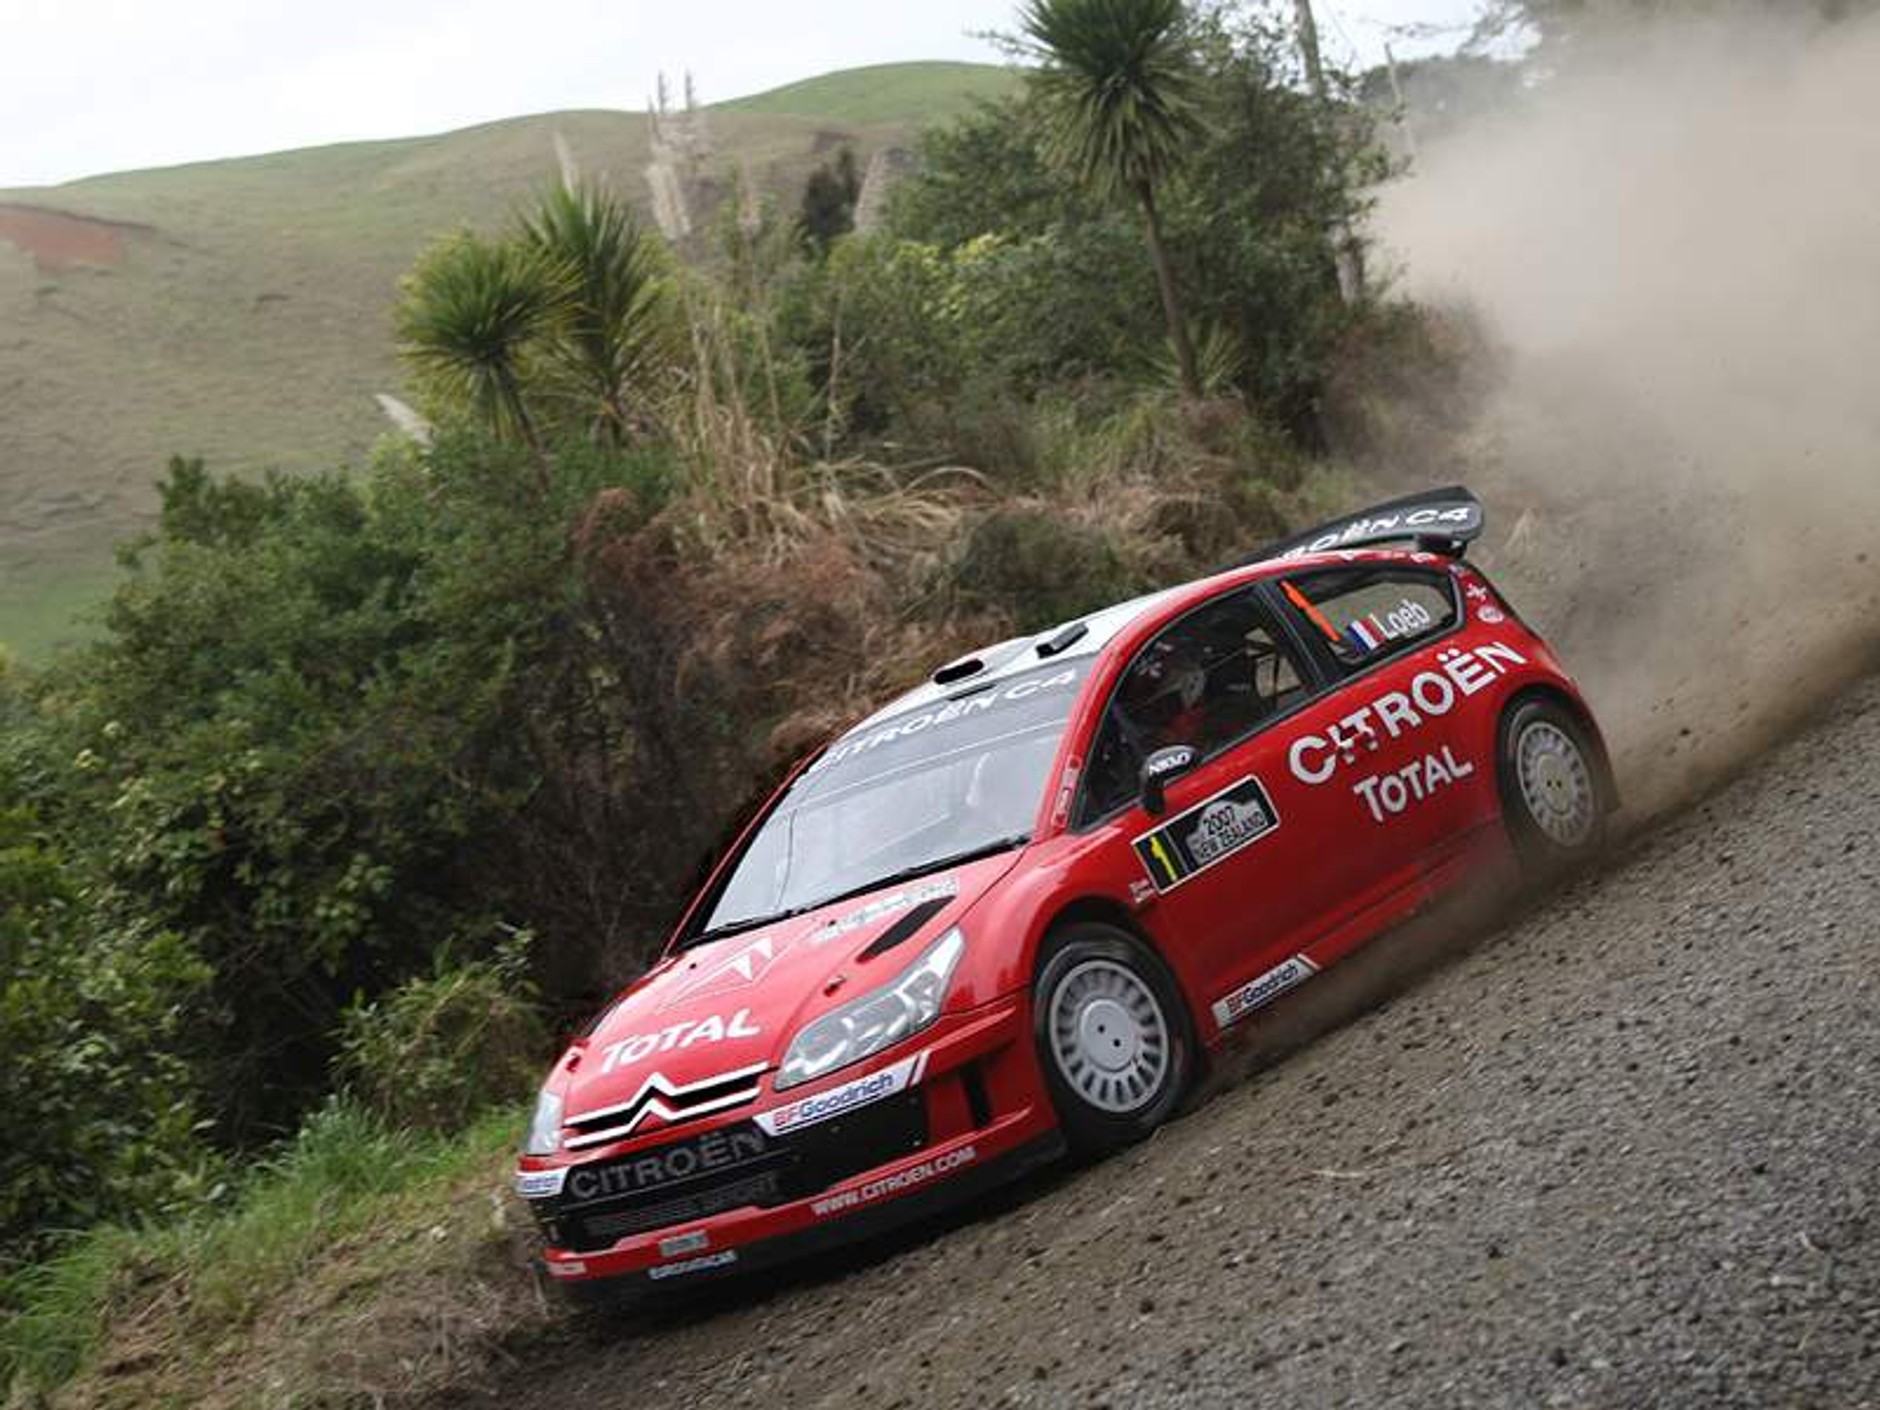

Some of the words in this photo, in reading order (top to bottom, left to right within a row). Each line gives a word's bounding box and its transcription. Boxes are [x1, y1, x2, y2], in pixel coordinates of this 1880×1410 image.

[1289, 641, 1528, 784] CITROËN
[1353, 744, 1474, 822] TOTAL
[1203, 805, 1235, 835] 2007
[1150, 835, 1179, 882] 1
[602, 1008, 761, 1073] TOTAL
[773, 1072, 894, 1127] BFGoodrich
[569, 1131, 764, 1199] CITROËN
